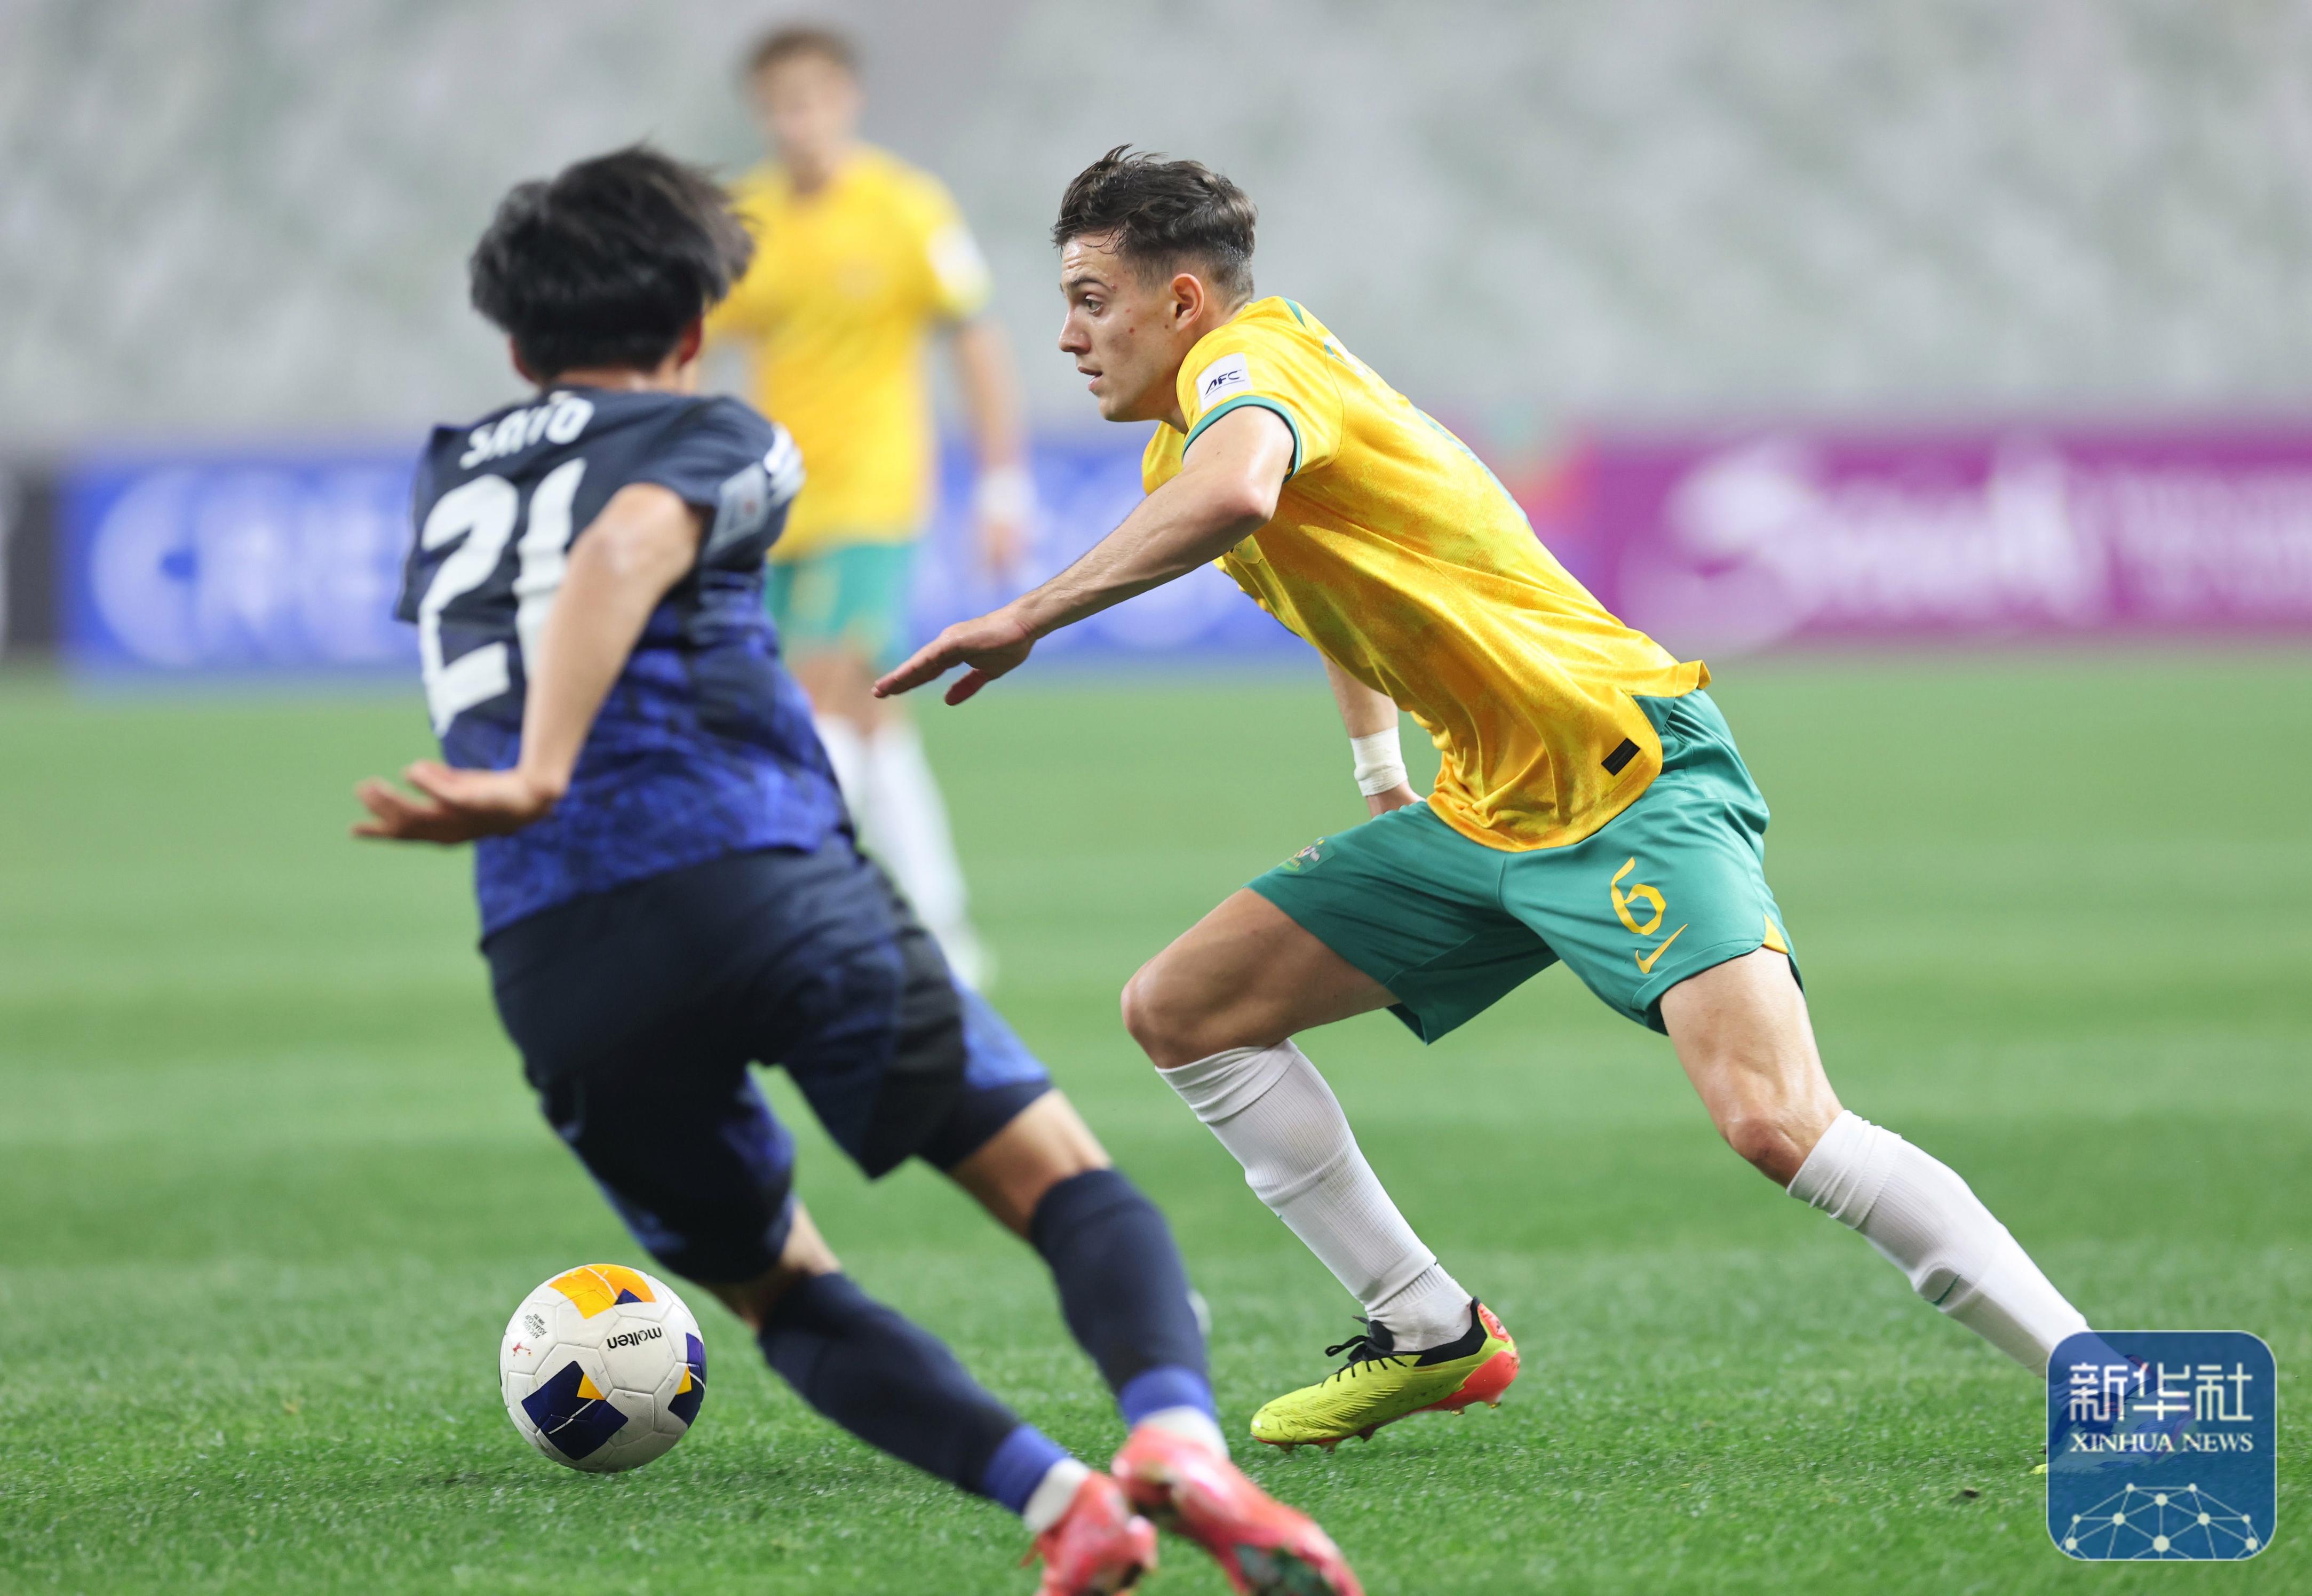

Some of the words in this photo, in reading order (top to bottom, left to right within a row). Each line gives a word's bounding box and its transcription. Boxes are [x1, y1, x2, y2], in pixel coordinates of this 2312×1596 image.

[1204, 369, 1242, 396] AFC
[418, 457, 587, 737] 21
[1610, 856, 1666, 936] 6
[607, 1327, 662, 1349] molten
